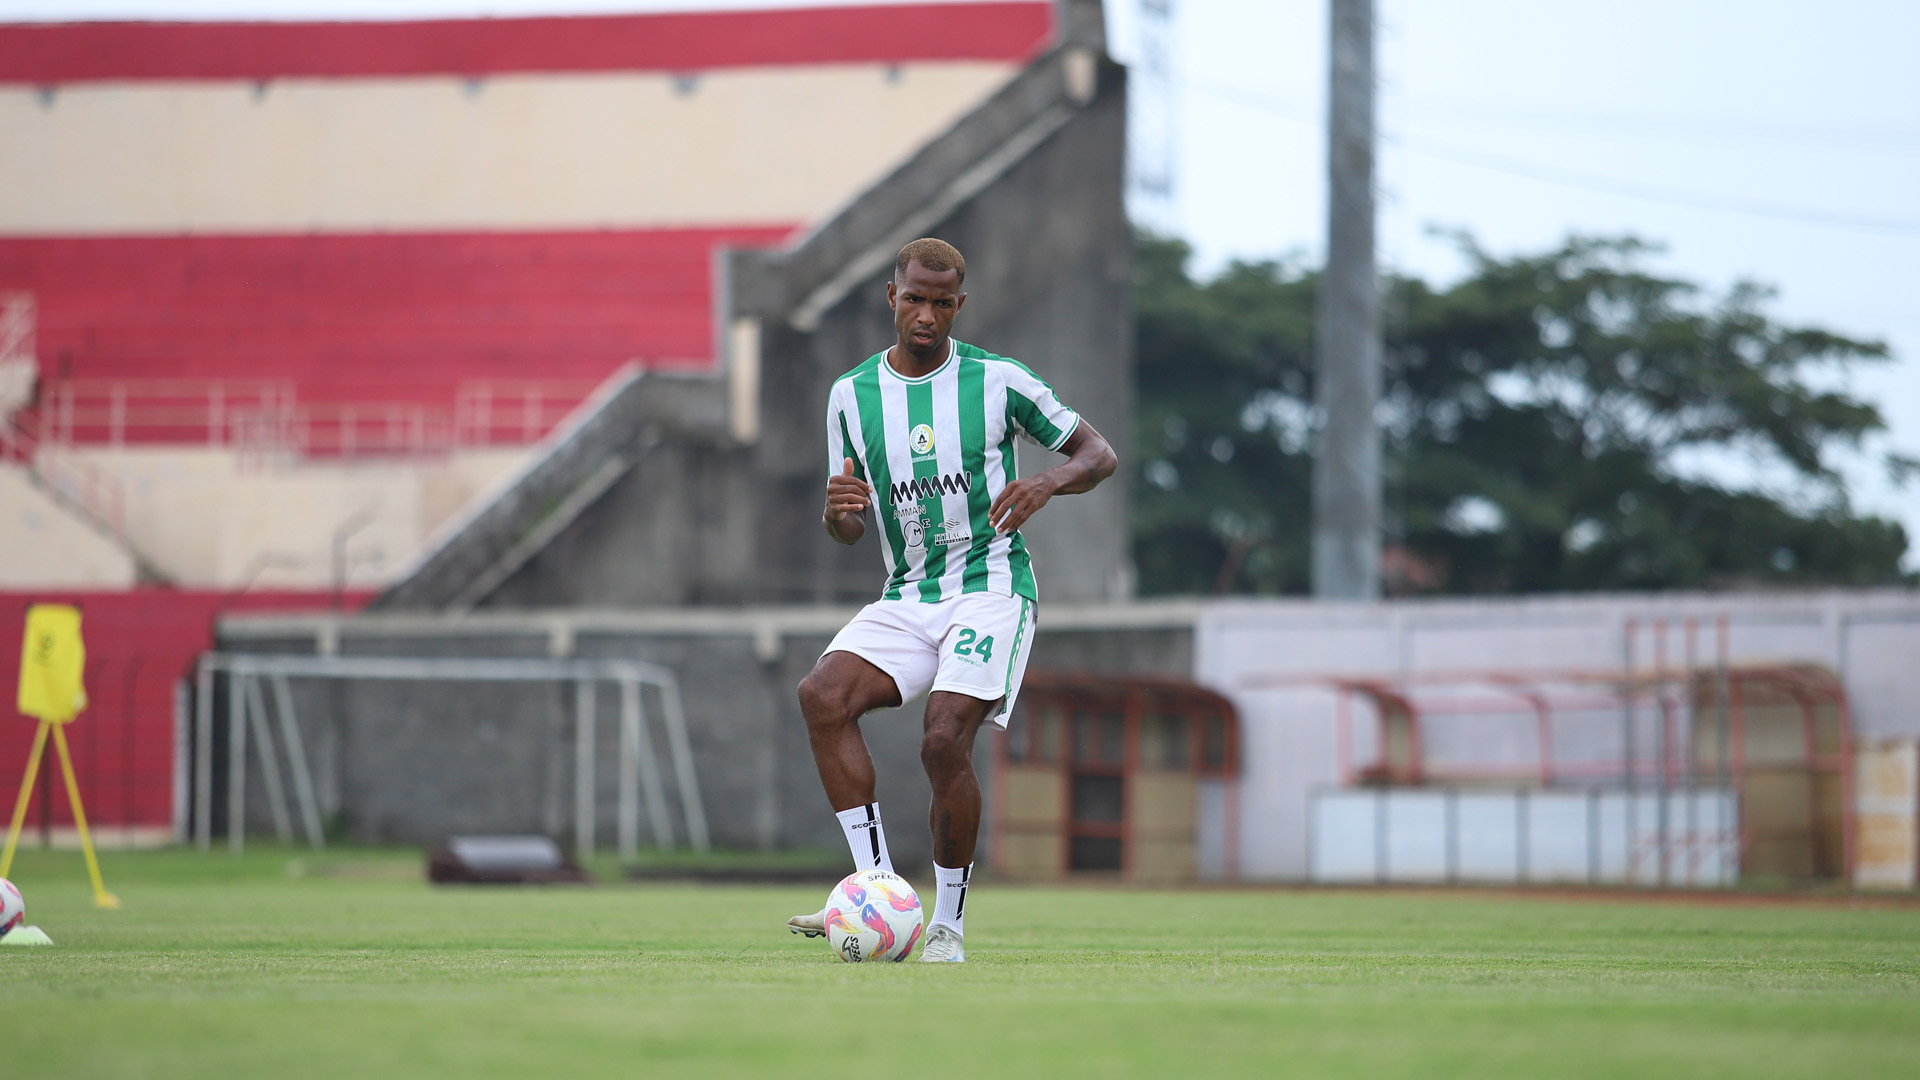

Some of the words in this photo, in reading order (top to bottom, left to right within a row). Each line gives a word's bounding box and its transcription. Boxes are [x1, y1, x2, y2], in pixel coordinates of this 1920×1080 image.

[893, 505, 927, 520] AMMAN
[954, 628, 994, 664] 24
[868, 874, 899, 882] SPECS
